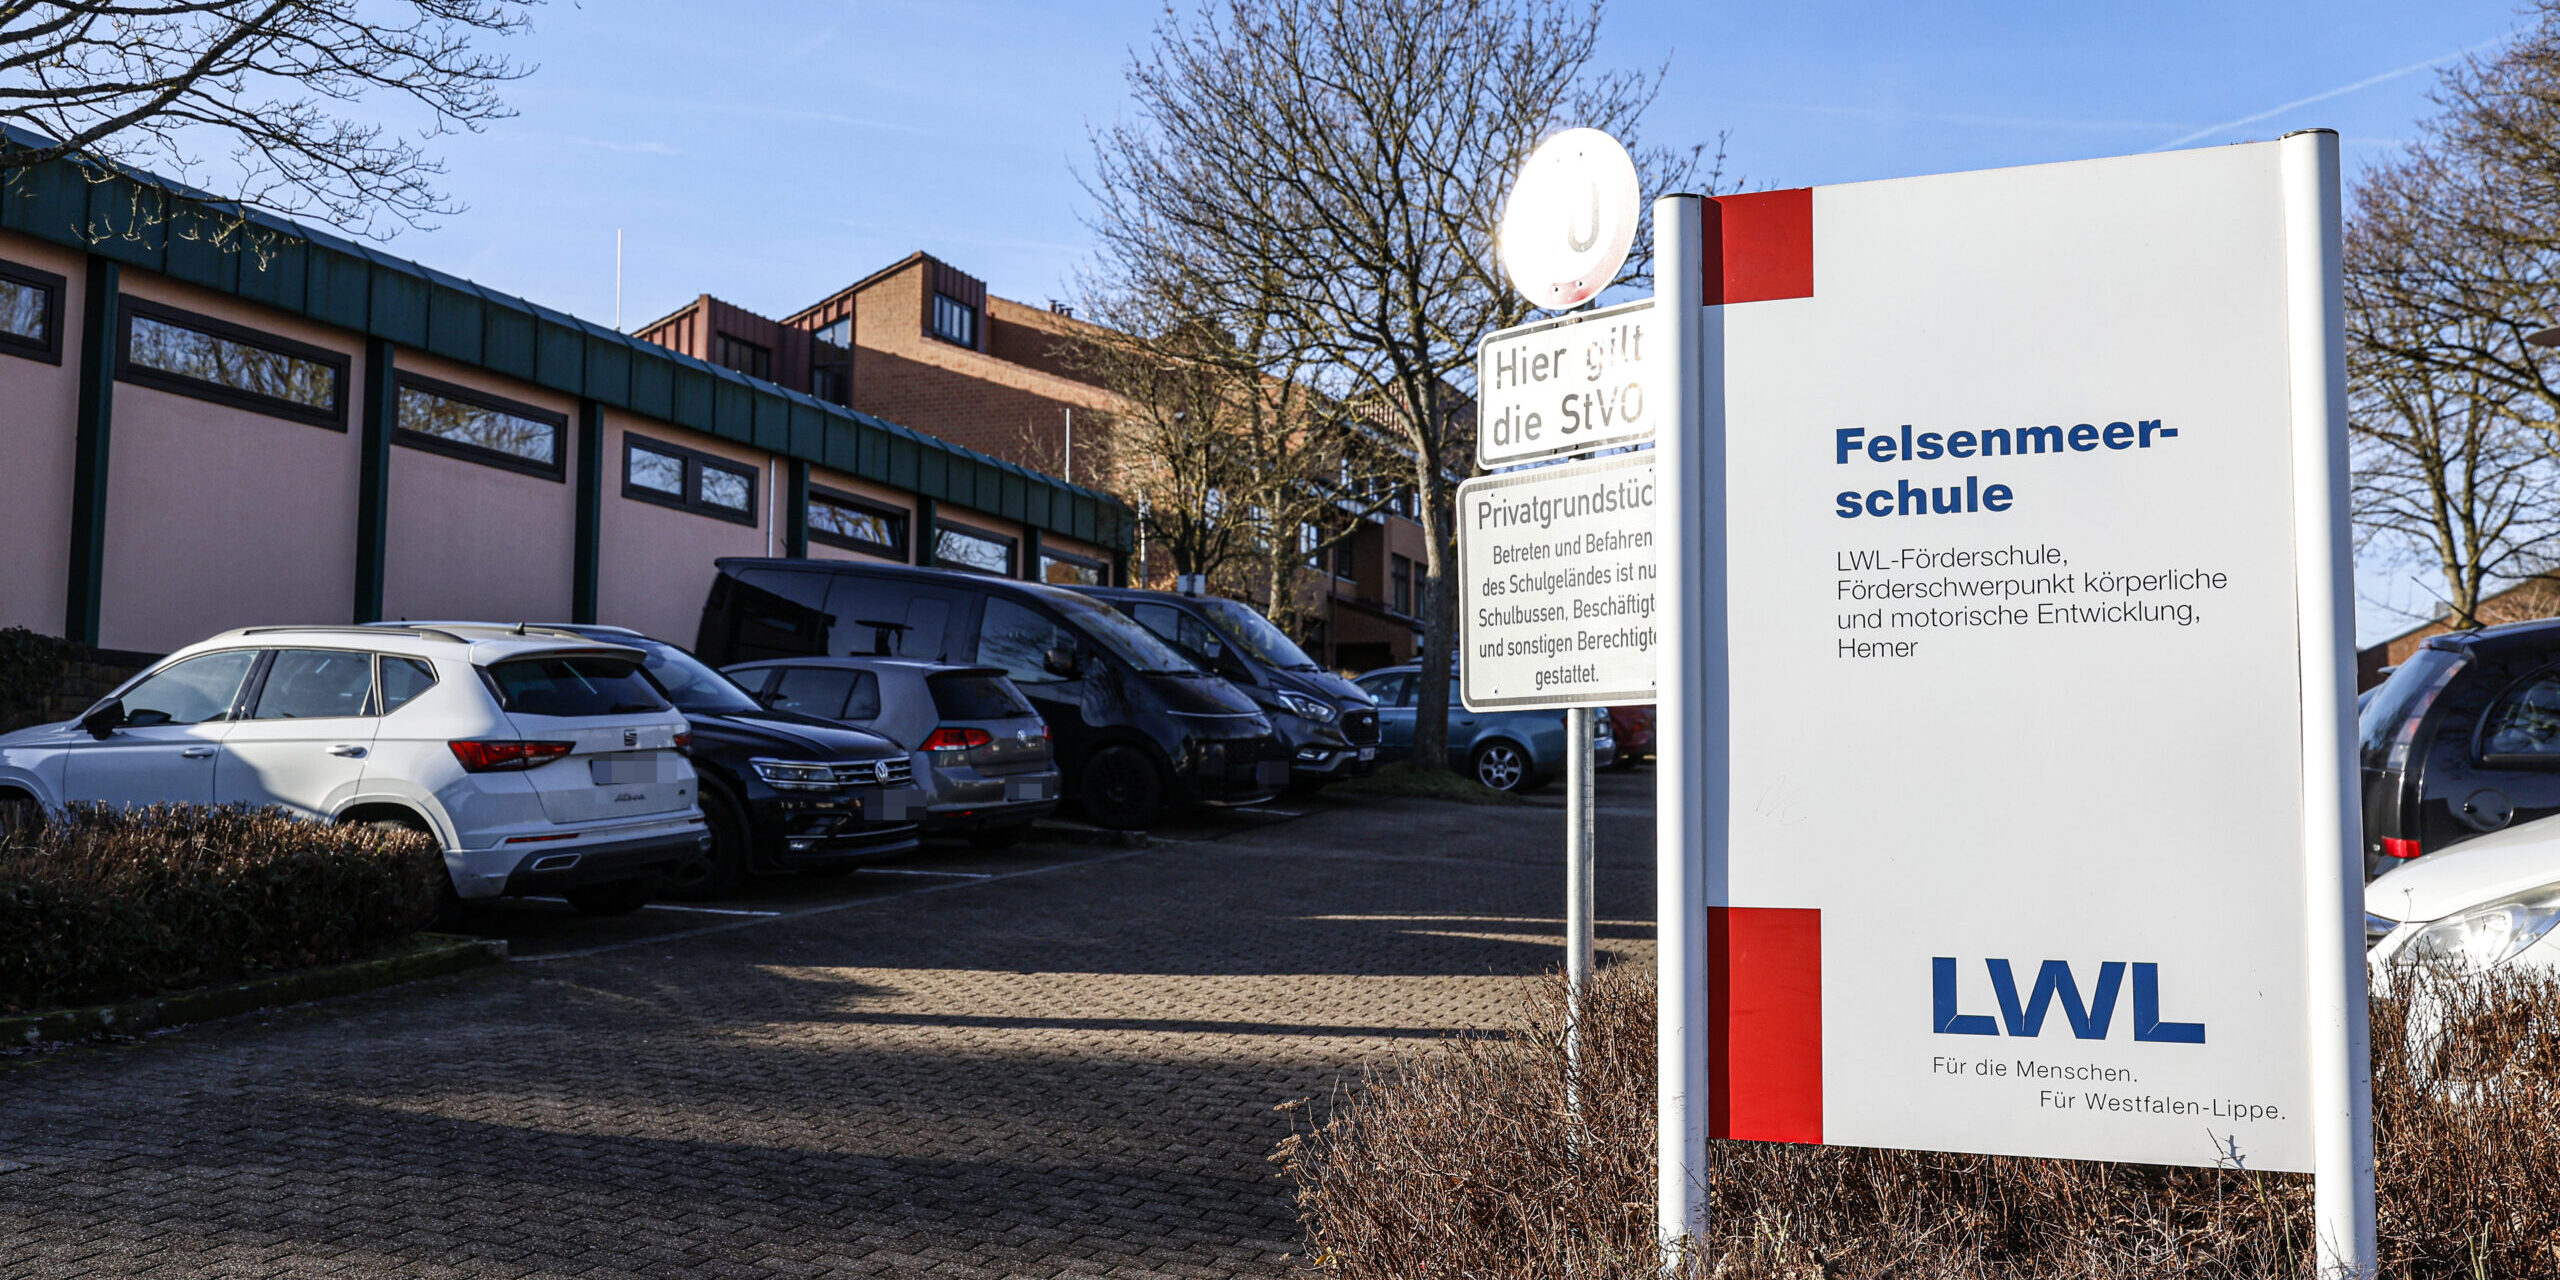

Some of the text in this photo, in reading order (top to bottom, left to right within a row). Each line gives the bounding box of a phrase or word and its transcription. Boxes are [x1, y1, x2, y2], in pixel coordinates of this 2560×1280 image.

[1496, 324, 1644, 390] Hier gilt
[1493, 382, 1644, 447] die StVO
[1836, 419, 2179, 464] Felsenmeer-
[1836, 476, 2014, 519] schule
[1493, 529, 1653, 565] Betreten und Befahren
[1837, 544, 2068, 572] LWL-Förderschule,
[1482, 562, 1656, 597] des Schulgeländes ist nu
[1837, 568, 2228, 601] Förderschwerpunkt körperliche
[1479, 593, 1656, 628] Schulbussen, Beschäftigt
[1837, 601, 2200, 630] und motorische Entwicklung,
[1479, 626, 1656, 659] und sonstigen Berechtigt
[1838, 638, 1919, 659] Hemer
[1535, 664, 1599, 691] gestattet.
[1931, 956, 2206, 1045] LWL
[1933, 1056, 2139, 1083] Für die Menschen.
[2040, 1090, 2287, 1123] Für Westfalen-Lippe.
